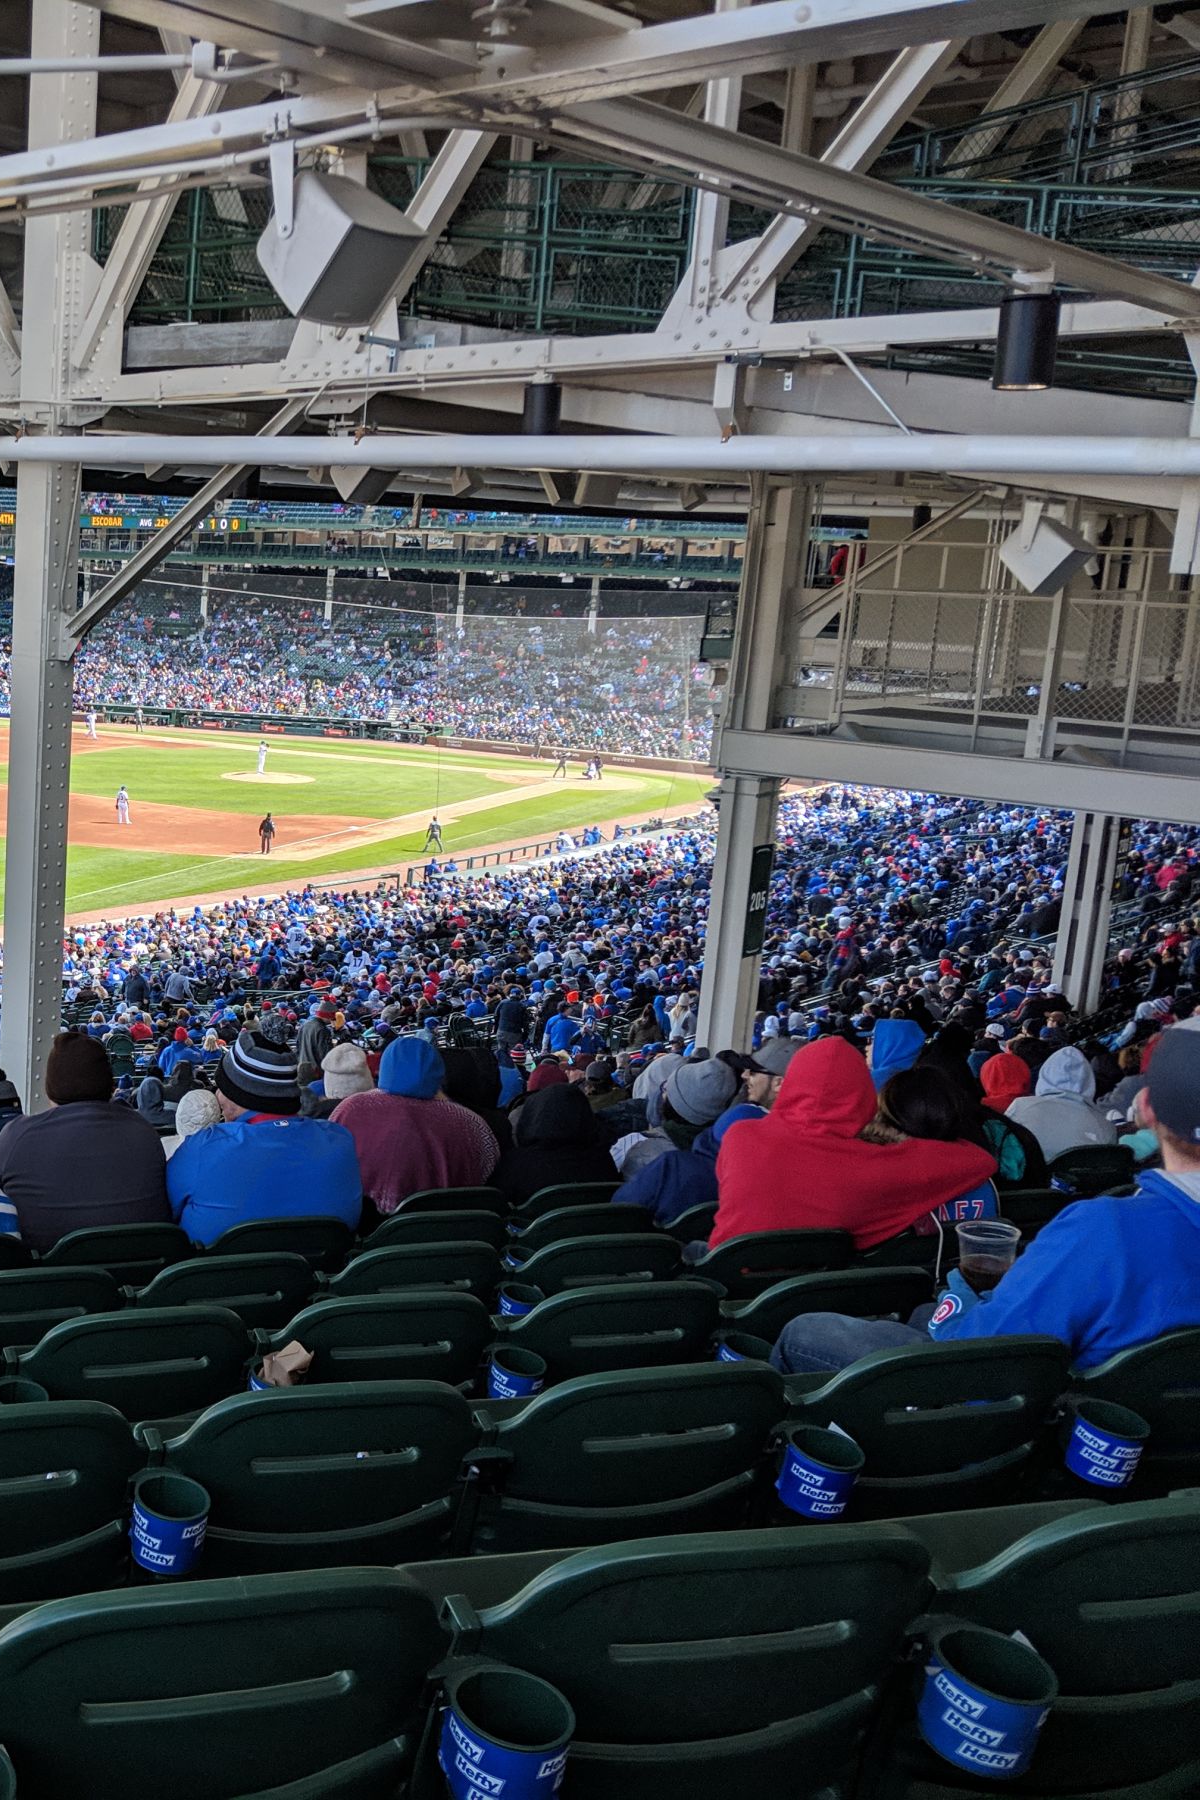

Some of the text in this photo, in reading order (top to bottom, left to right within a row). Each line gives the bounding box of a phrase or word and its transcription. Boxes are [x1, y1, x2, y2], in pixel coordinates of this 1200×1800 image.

[0, 512, 15, 524] 4TH
[91, 516, 123, 526] ESCOBAR
[139, 518, 153, 527] AVG
[210, 519, 216, 529] 1
[220, 519, 228, 529] 0
[231, 519, 239, 530] 0
[749, 890, 767, 912] 205
[353, 957, 363, 968] 17
[1077, 1427, 1105, 1450] Hefty
[1083, 1448, 1116, 1468] Hefty
[791, 1464, 821, 1484] Hefty
[1092, 1467, 1124, 1482] Hefty
[802, 1485, 834, 1500] Hefty
[141, 1547, 175, 1566] Hefty
[936, 1676, 980, 1716] Hefty
[946, 1711, 1000, 1746] Hefty
[450, 1719, 482, 1761] Hefty
[961, 1744, 1017, 1767] Hefty
[456, 1755, 504, 1795] Hefty
